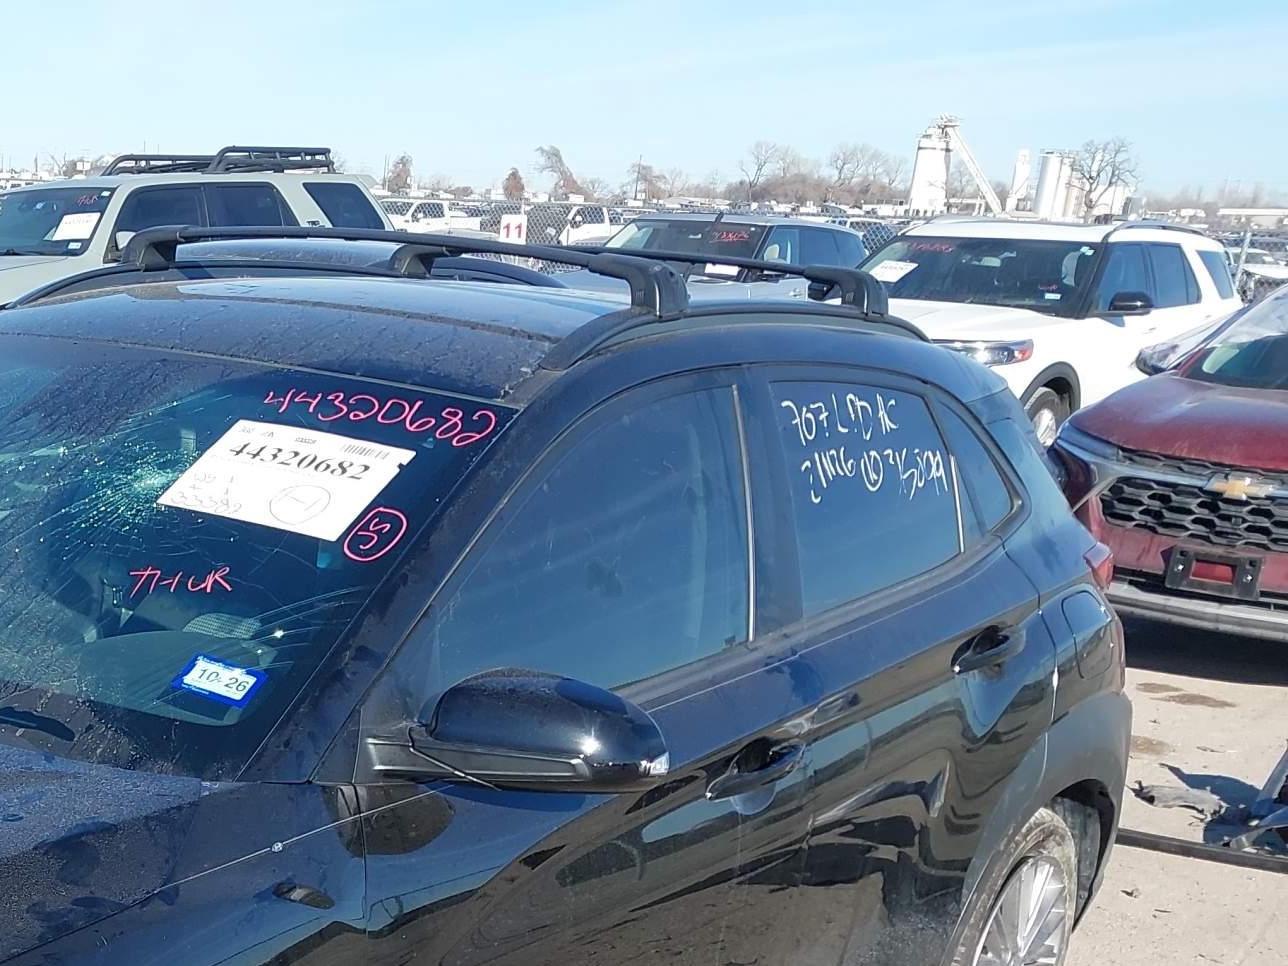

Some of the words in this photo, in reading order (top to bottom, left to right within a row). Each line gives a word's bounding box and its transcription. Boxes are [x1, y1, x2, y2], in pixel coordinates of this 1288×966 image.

[503, 222, 523, 239] 11
[263, 387, 497, 447] 44320682
[229, 441, 371, 480] 44320682
[129, 566, 232, 599] THUR
